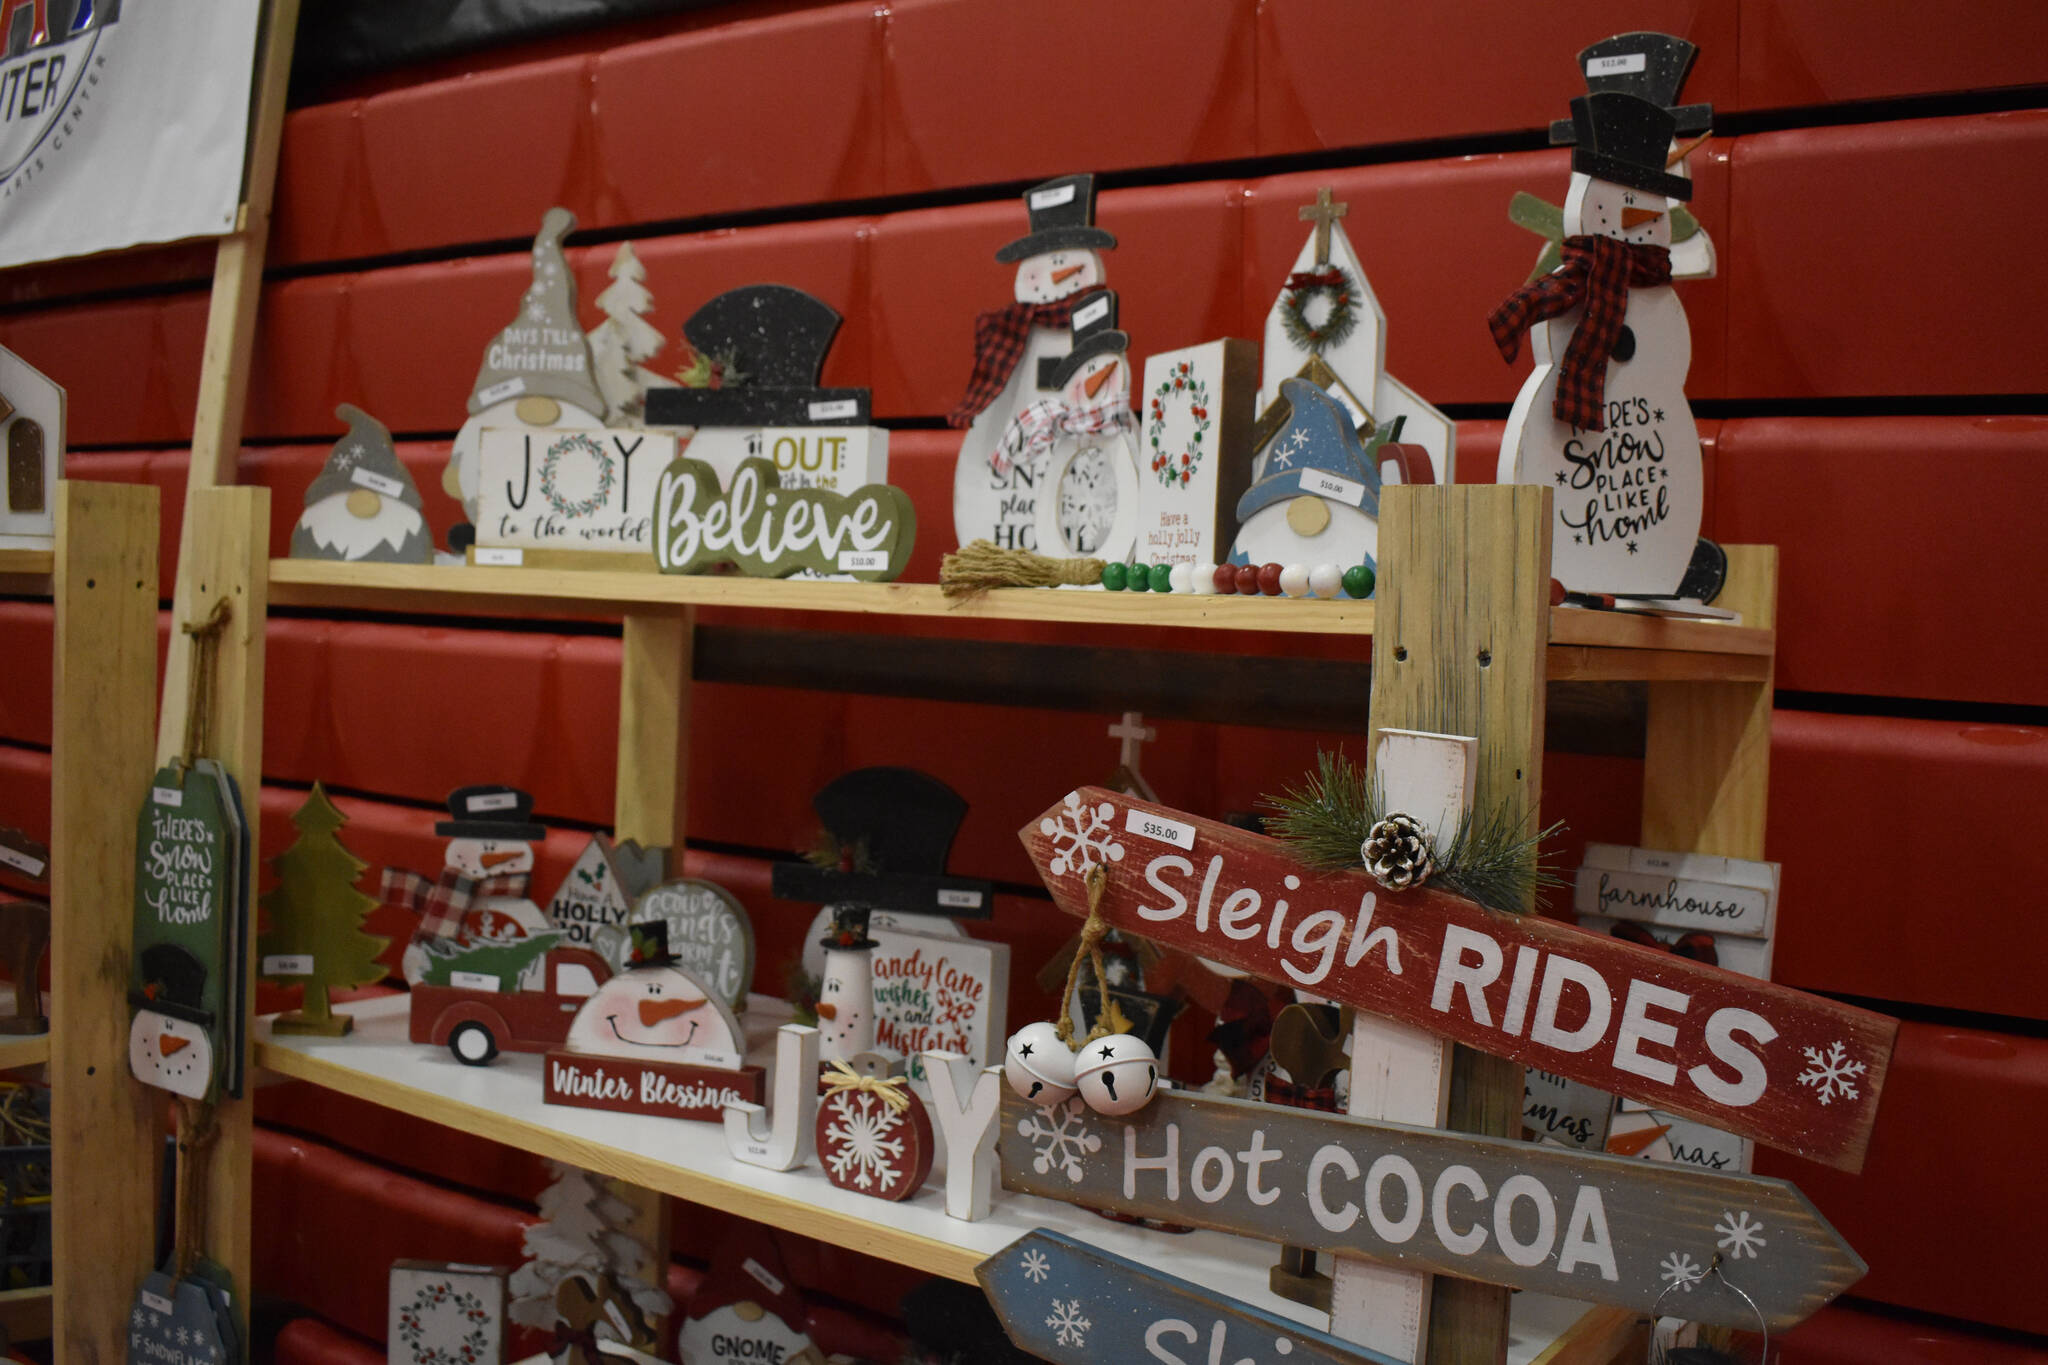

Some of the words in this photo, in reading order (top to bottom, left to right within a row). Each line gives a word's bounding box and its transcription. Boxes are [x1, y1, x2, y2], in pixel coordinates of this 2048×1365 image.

[0, 54, 66, 122] TER
[52, 55, 107, 151] CENTER
[503, 329, 538, 346] DAYS
[488, 345, 584, 373] Christmas
[1563, 430, 1665, 490] Snow
[1597, 466, 1657, 494] PLACE
[1560, 485, 1670, 546] home
[1605, 489, 1650, 513] LIKE
[499, 513, 521, 540] to
[534, 514, 567, 541] the
[580, 516, 652, 543] world
[657, 466, 892, 569] Believe
[1160, 511, 1181, 527] Have
[1183, 513, 1189, 525] a
[1148, 529, 1174, 548] holly
[1175, 528, 1200, 548] jolly
[850, 557, 876, 567] $10.00
[152, 812, 206, 843] THERE'S
[1143, 821, 1179, 841] $35.00
[151, 840, 213, 879] Snow
[167, 871, 206, 889] PLACE
[1597, 872, 1746, 919] farmhouse
[144, 886, 212, 926] home
[170, 887, 201, 905] LIKE
[552, 899, 626, 923] HOLLY
[874, 979, 930, 1011] wishes
[1137, 855, 1402, 985] Sleigh
[1431, 923, 1779, 1106] RIDES
[904, 1006, 934, 1025] and
[876, 1017, 973, 1057] Mistletoe
[552, 1061, 633, 1100] Winter
[1122, 1123, 1284, 1206] Hot
[1306, 1144, 1620, 1281] COCOA
[711, 1333, 786, 1365] GNOME
